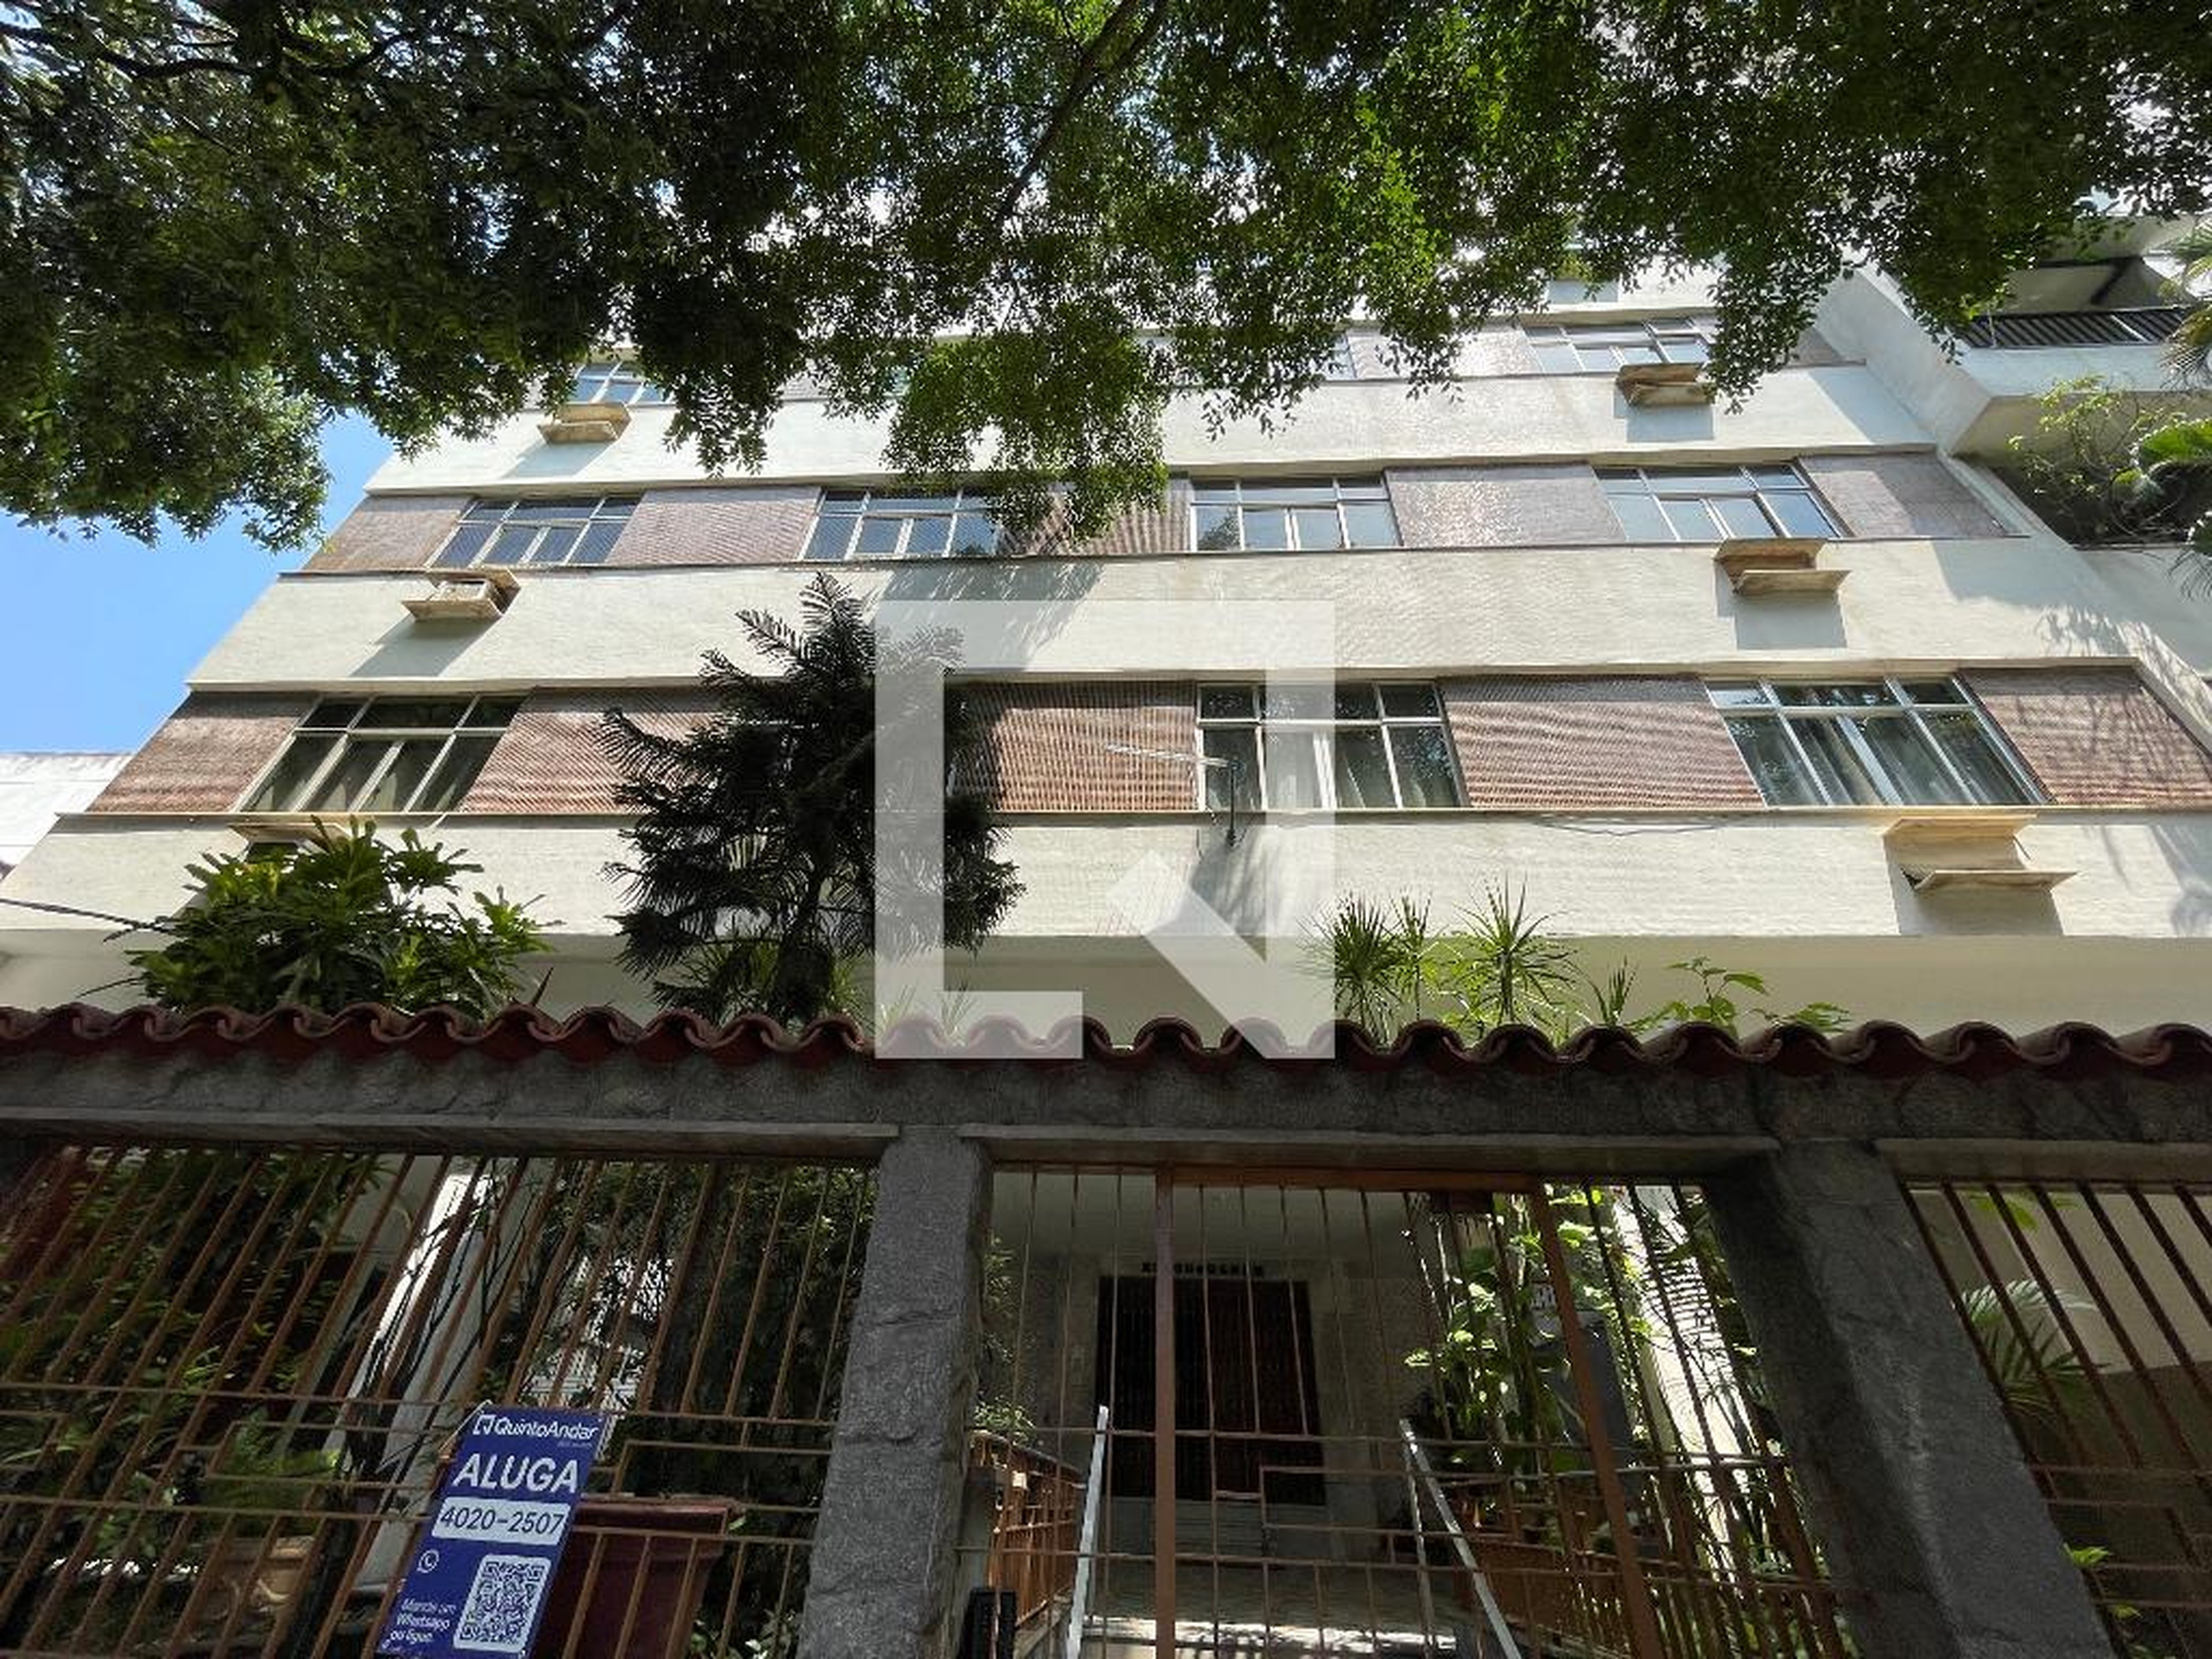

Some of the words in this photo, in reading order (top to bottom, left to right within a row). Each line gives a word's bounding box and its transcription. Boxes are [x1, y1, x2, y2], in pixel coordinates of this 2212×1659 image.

[494, 1416, 600, 1440] QuintoAndar
[453, 1453, 578, 1494] ALUGA
[440, 1507, 565, 1535] 4020-2507
